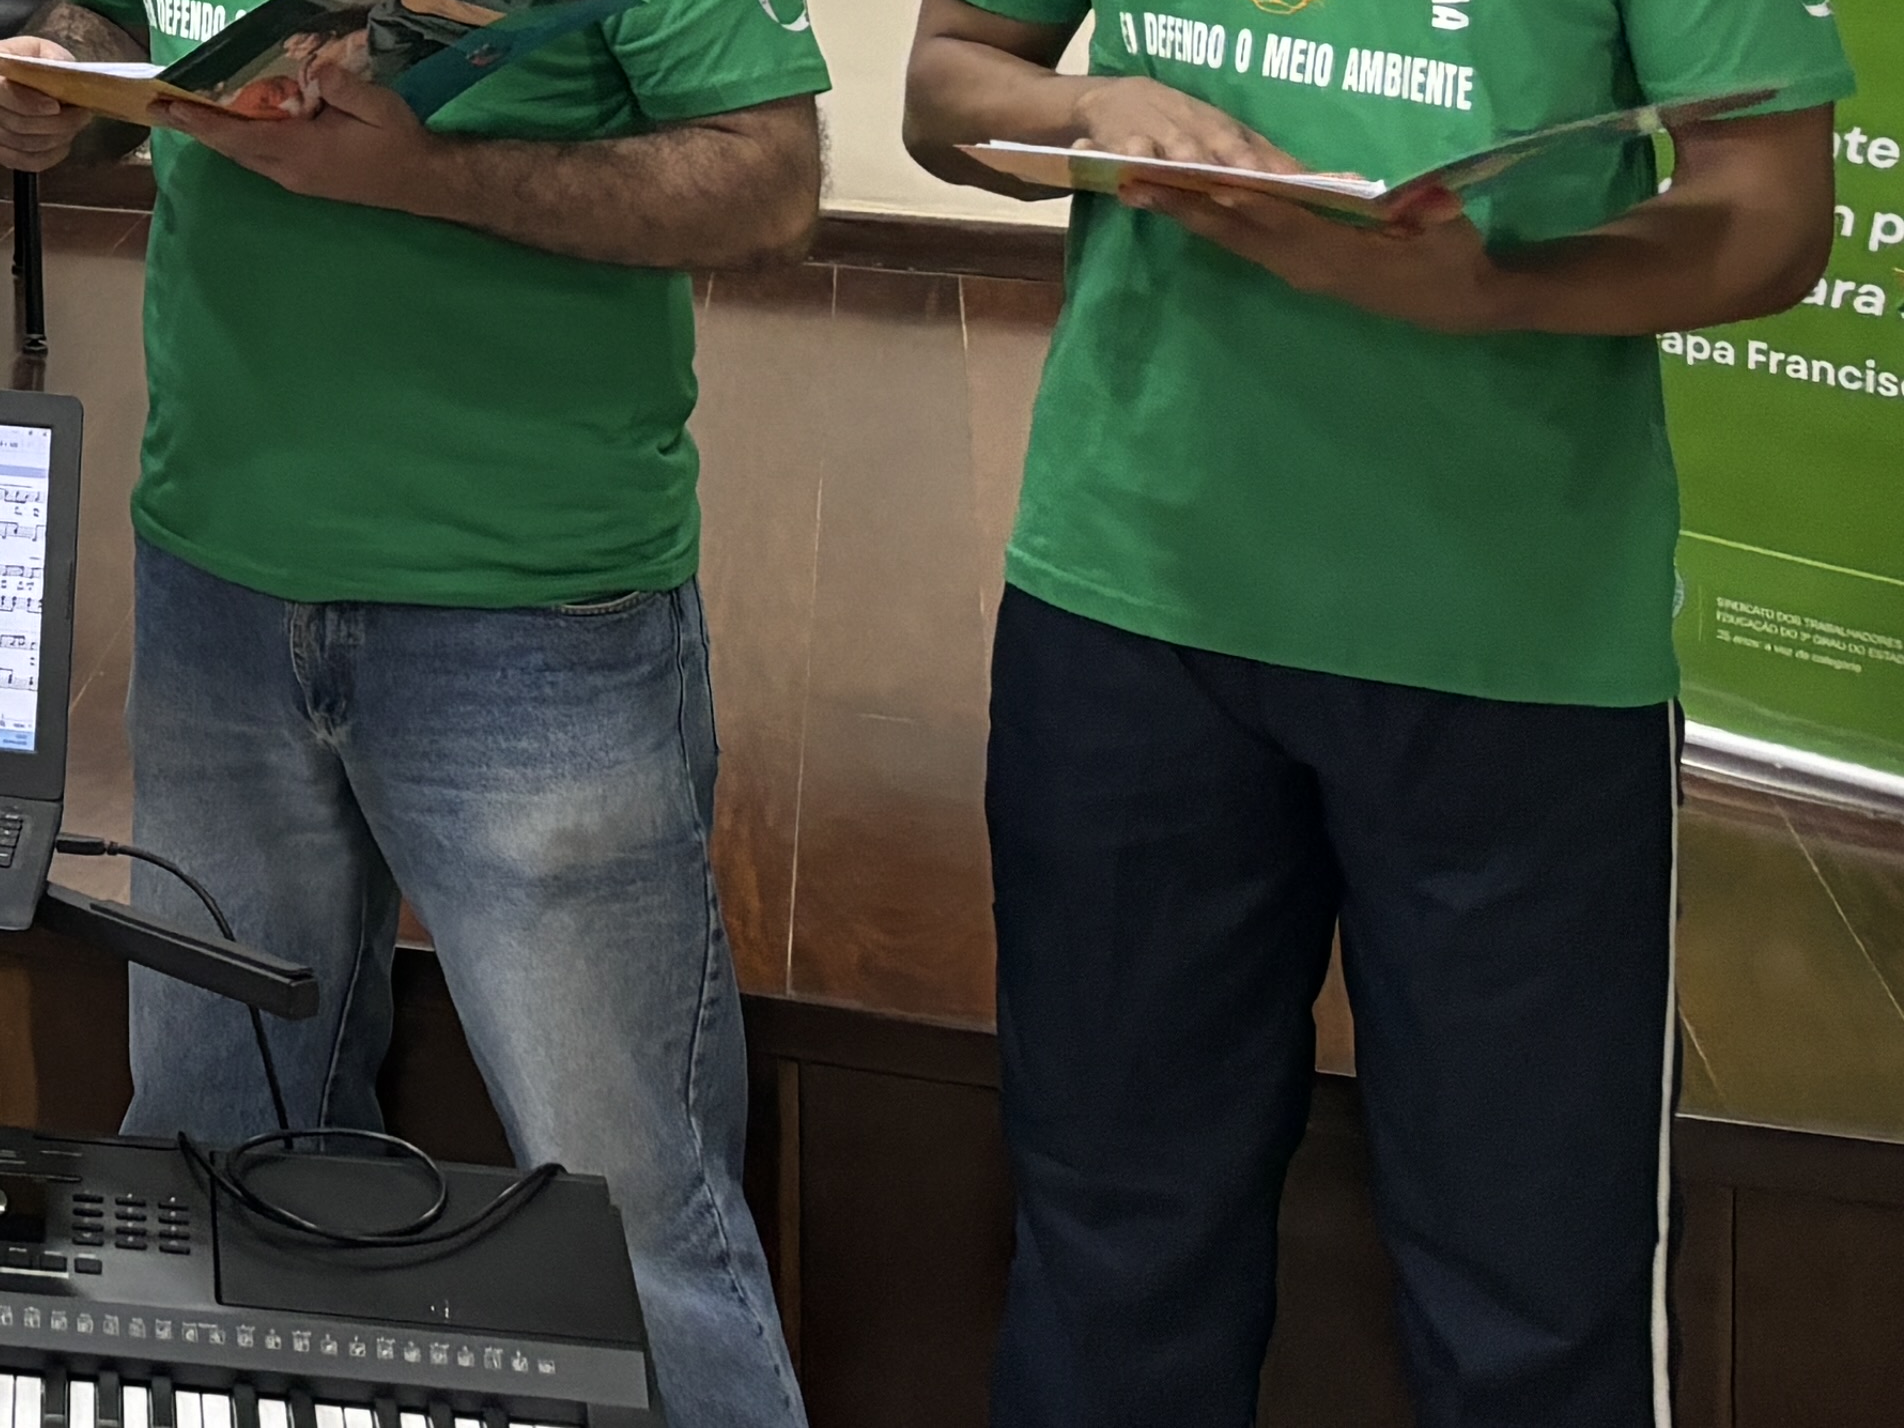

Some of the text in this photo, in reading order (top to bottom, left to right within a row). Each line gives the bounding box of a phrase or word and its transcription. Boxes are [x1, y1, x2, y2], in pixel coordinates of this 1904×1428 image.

[1143, 12, 1225, 69] DEFENDO
[1235, 28, 1252, 73] O
[1262, 33, 1334, 87] MEIO
[1342, 48, 1473, 110] AMBIENTE
[1656, 331, 1904, 397] apa Francis
[1780, 626, 1798, 639] DO
